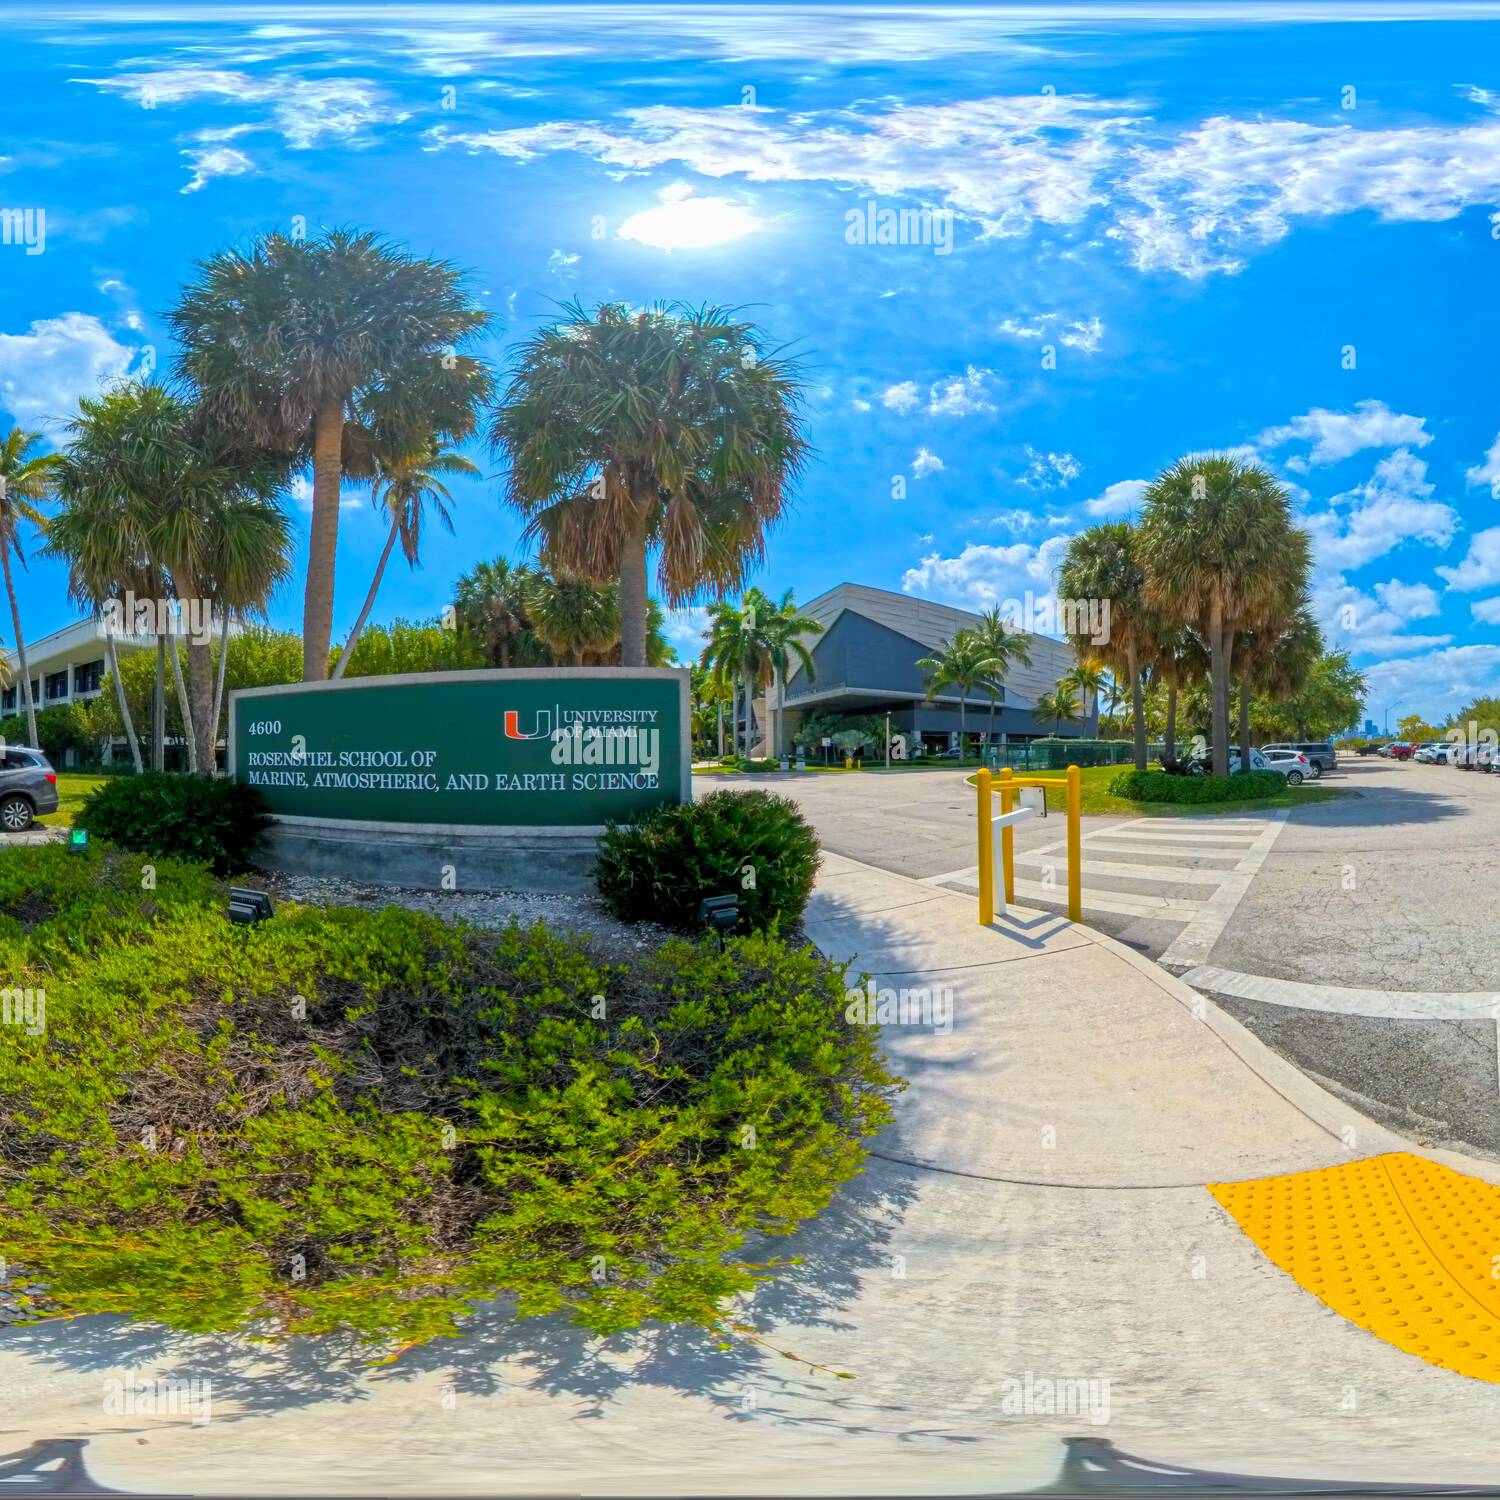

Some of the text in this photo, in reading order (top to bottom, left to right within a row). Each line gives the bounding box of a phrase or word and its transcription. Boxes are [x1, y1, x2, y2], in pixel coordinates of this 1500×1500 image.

[563, 710, 659, 723] UNIVERSITY
[248, 720, 281, 735] 4600
[504, 710, 550, 740] U
[564, 726, 638, 738] OF MIAMI
[248, 750, 437, 767] ROSENSTIEL SCHOOL OF
[248, 771, 659, 793] MARINE, ATMOSPHERIC, AND EARTH SCIENCE
